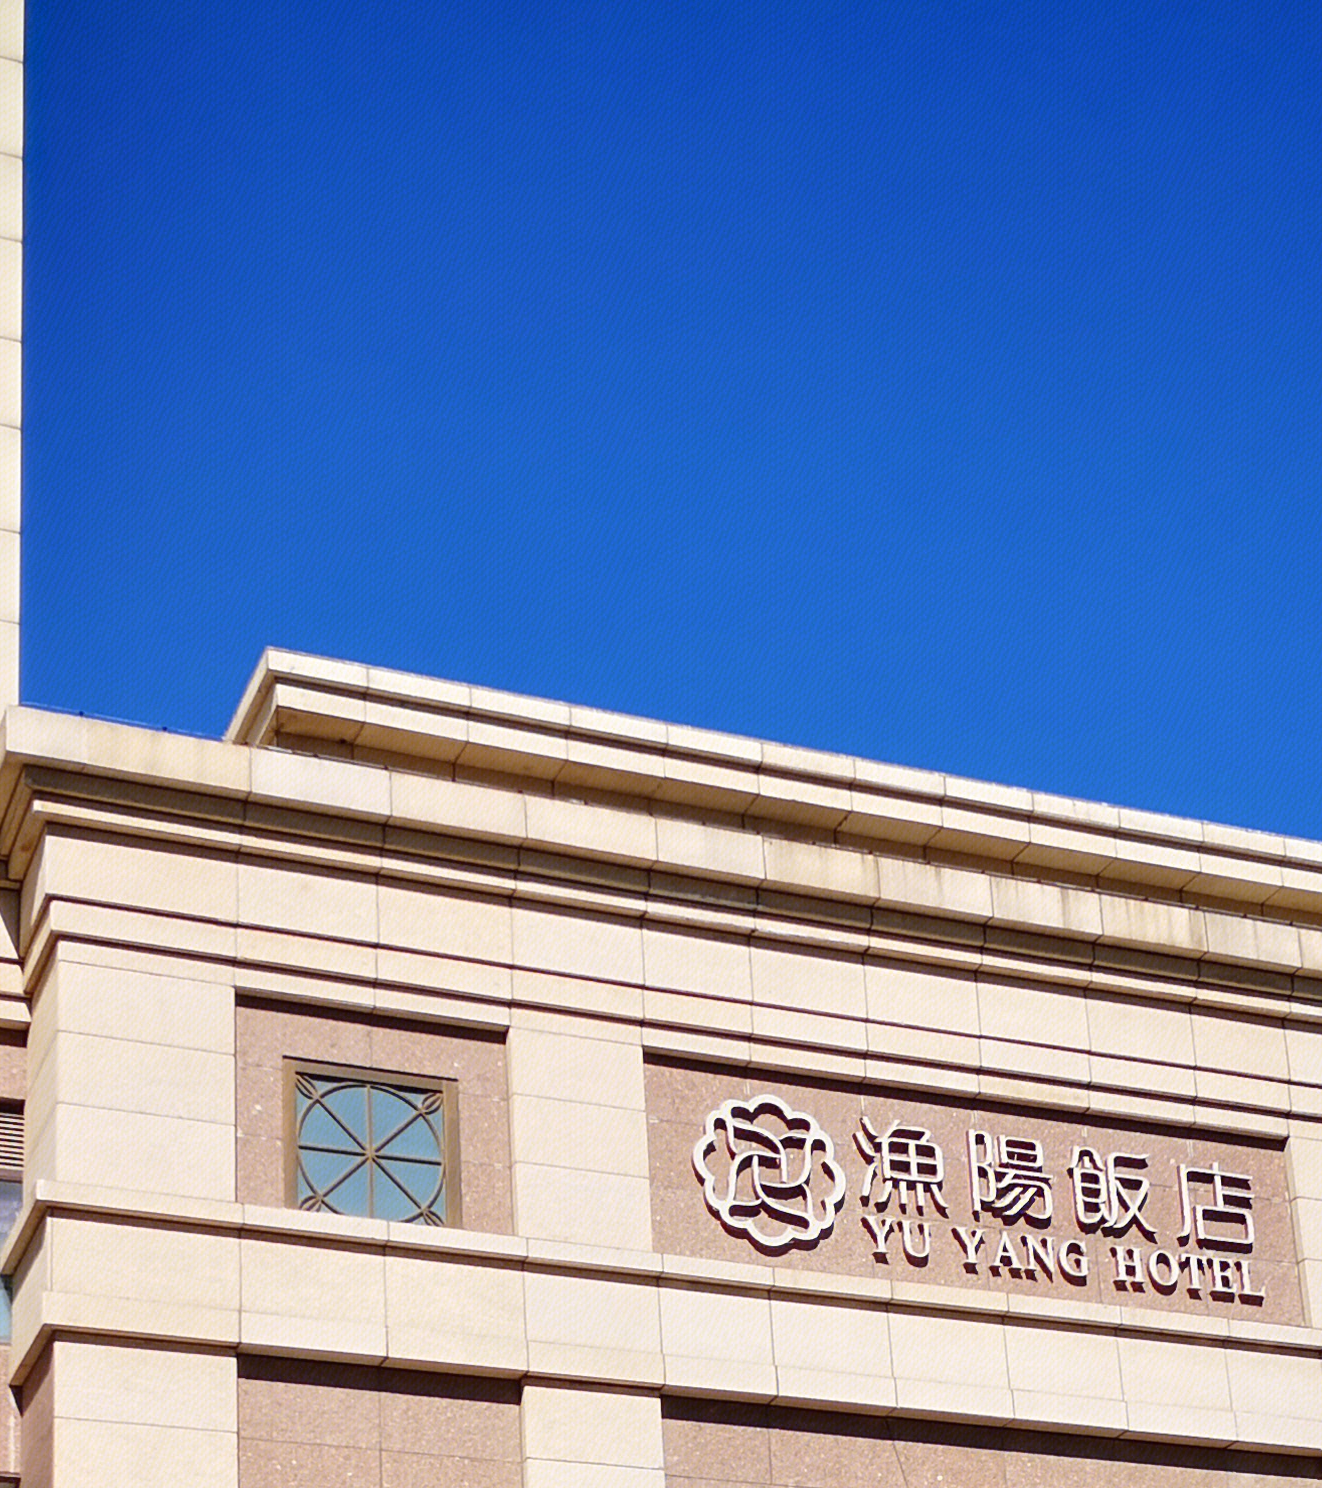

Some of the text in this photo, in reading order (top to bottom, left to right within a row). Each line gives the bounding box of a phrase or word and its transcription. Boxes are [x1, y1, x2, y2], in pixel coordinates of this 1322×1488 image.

[853, 1115, 1256, 1246] 漁陽飯店
[861, 1215, 1266, 1298] YU YANG HOTEL
